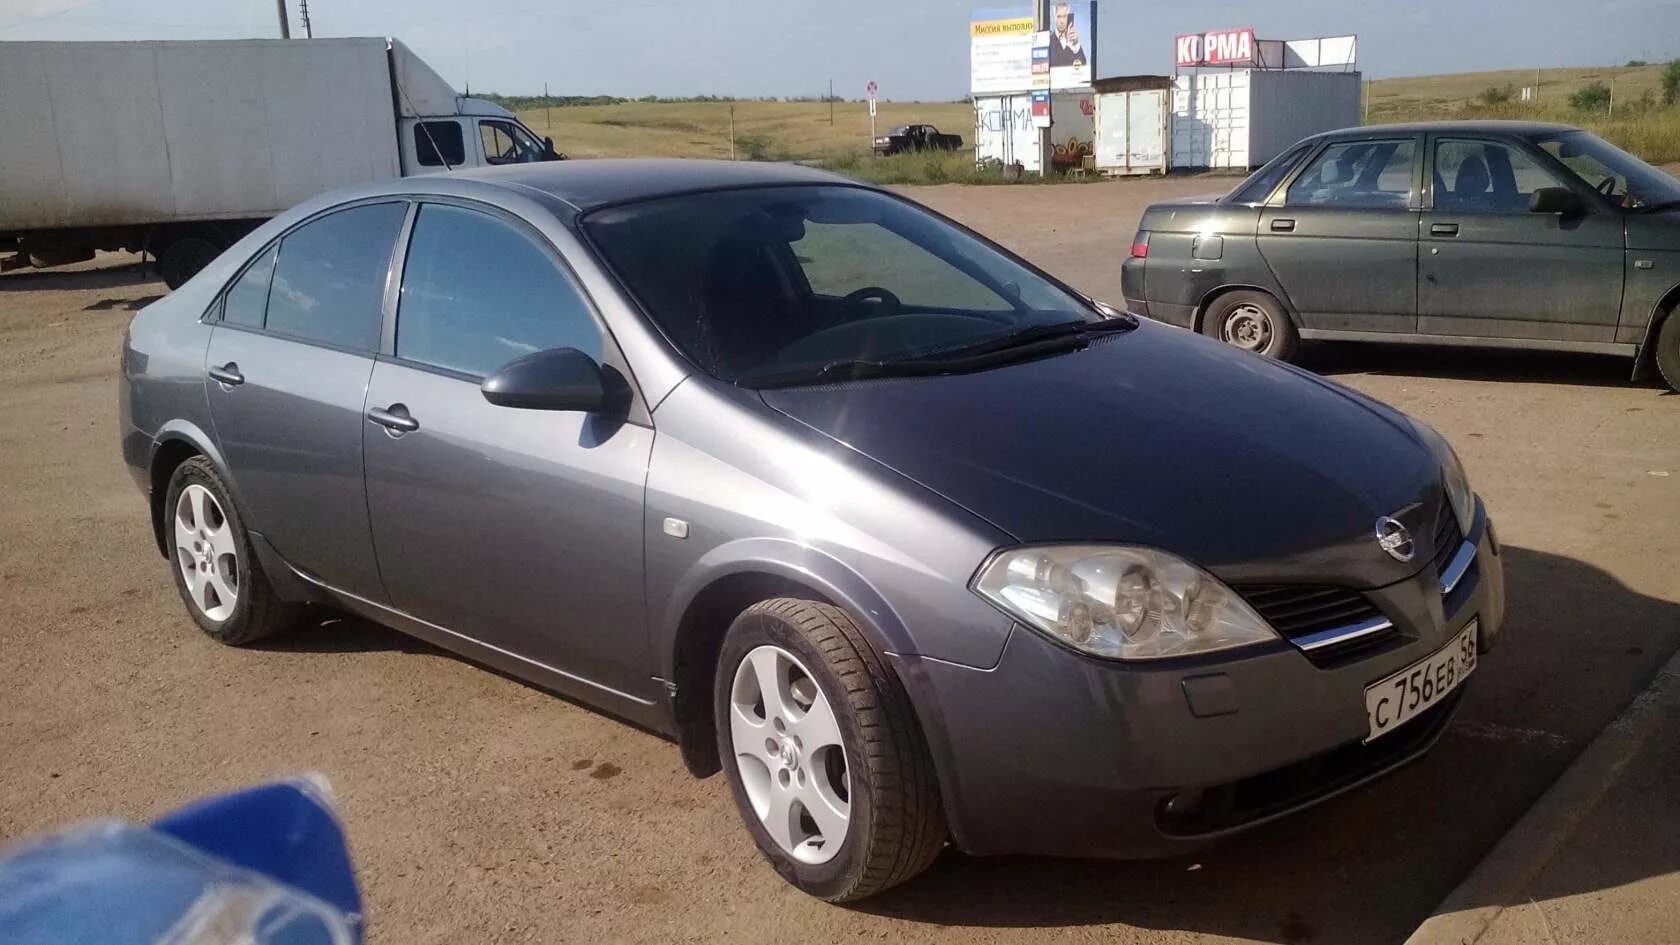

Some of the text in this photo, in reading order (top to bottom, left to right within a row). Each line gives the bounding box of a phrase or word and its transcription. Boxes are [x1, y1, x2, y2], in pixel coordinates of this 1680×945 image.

[975, 24, 1001, 34] Миссия
[1177, 31, 1251, 64] КОРМА
[1460, 630, 1475, 664] 56
